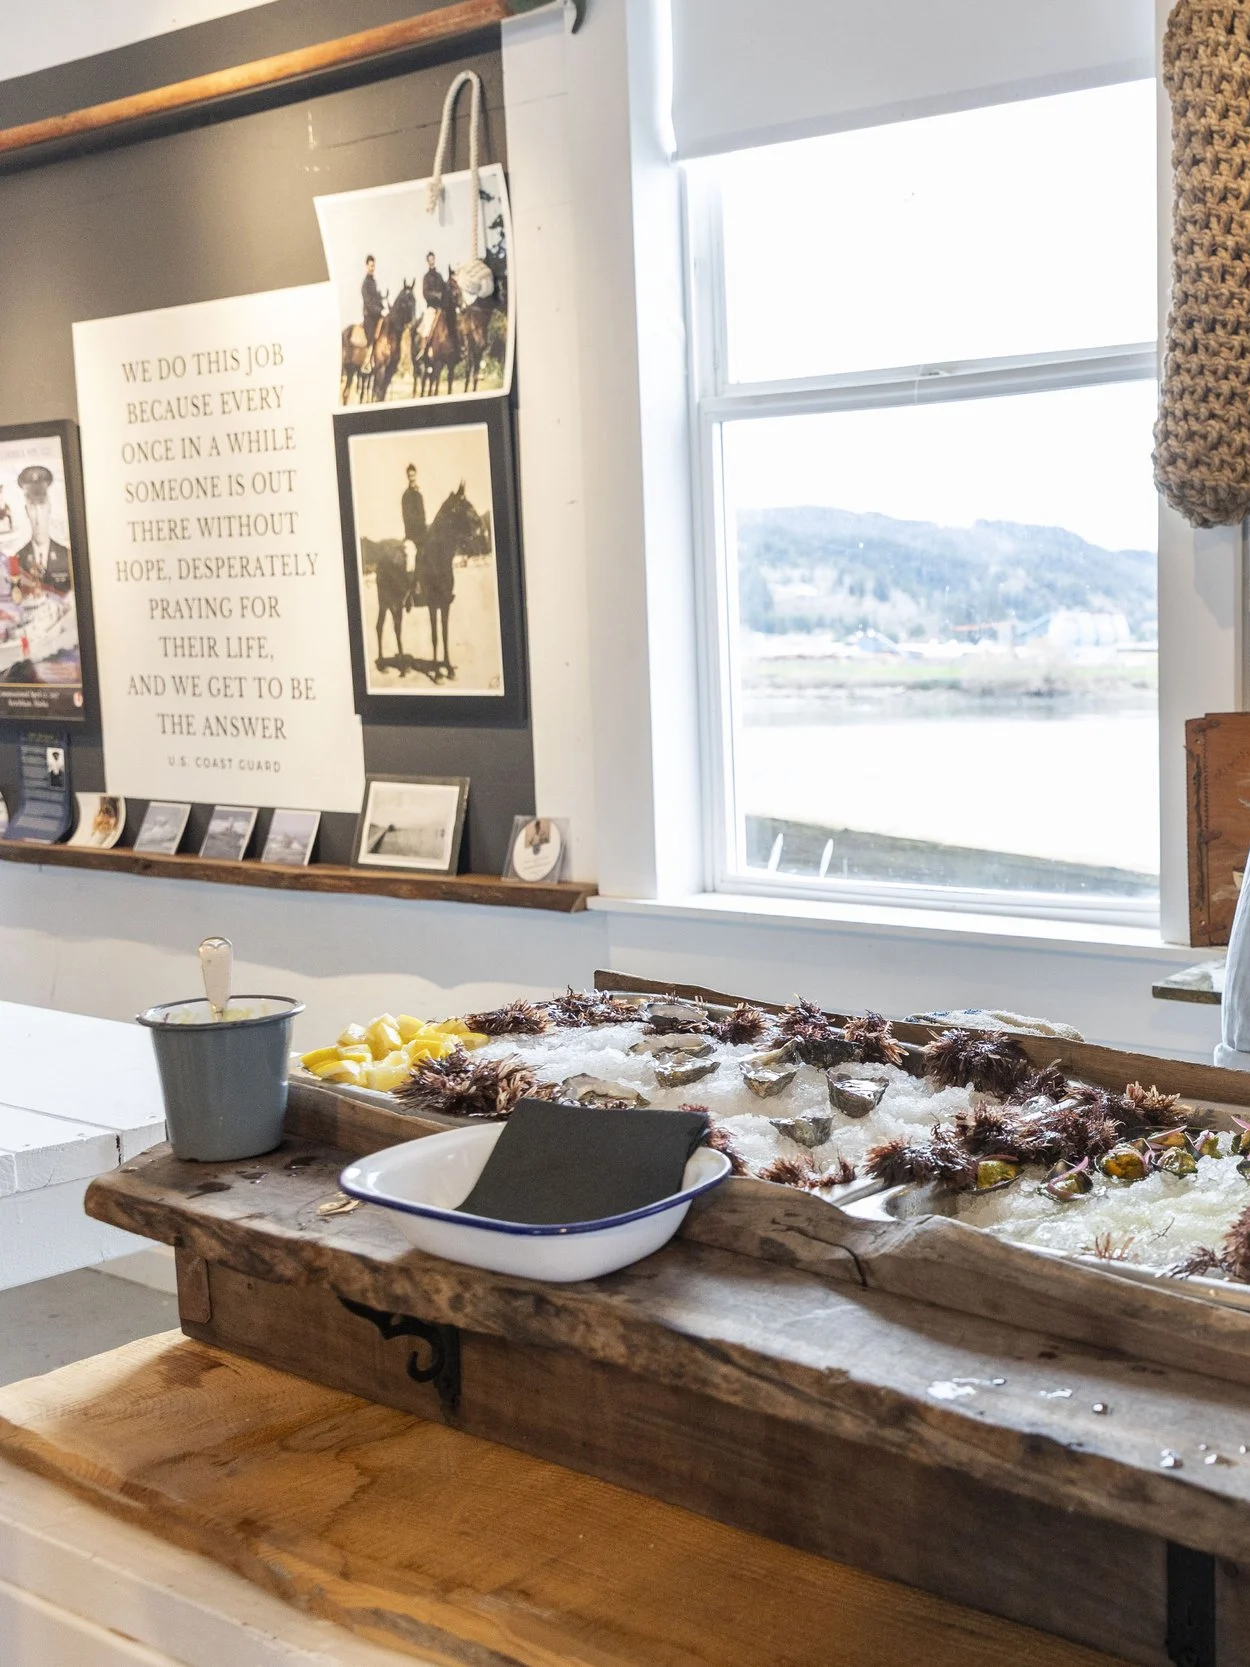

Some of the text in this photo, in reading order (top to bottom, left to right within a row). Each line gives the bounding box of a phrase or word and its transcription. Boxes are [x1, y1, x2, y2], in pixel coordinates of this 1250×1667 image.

[122, 343, 285, 383] WE DO THIS JOB
[127, 385, 284, 425] BECAUSE EVERY
[121, 427, 297, 465] ONCE IN A WHILE
[124, 469, 297, 504] SOMEONE IS OUT
[127, 511, 299, 543] THERE WITHOUT
[115, 553, 319, 584] HOPE, DESPERATELY
[149, 596, 281, 620] PRAYING FOR
[159, 636, 274, 662] THEIR LIFE,
[127, 675, 317, 700] AND WE GET TO BE
[157, 713, 287, 740] THE ANSWER
[168, 756, 281, 773] U.S. COAST GUARD
